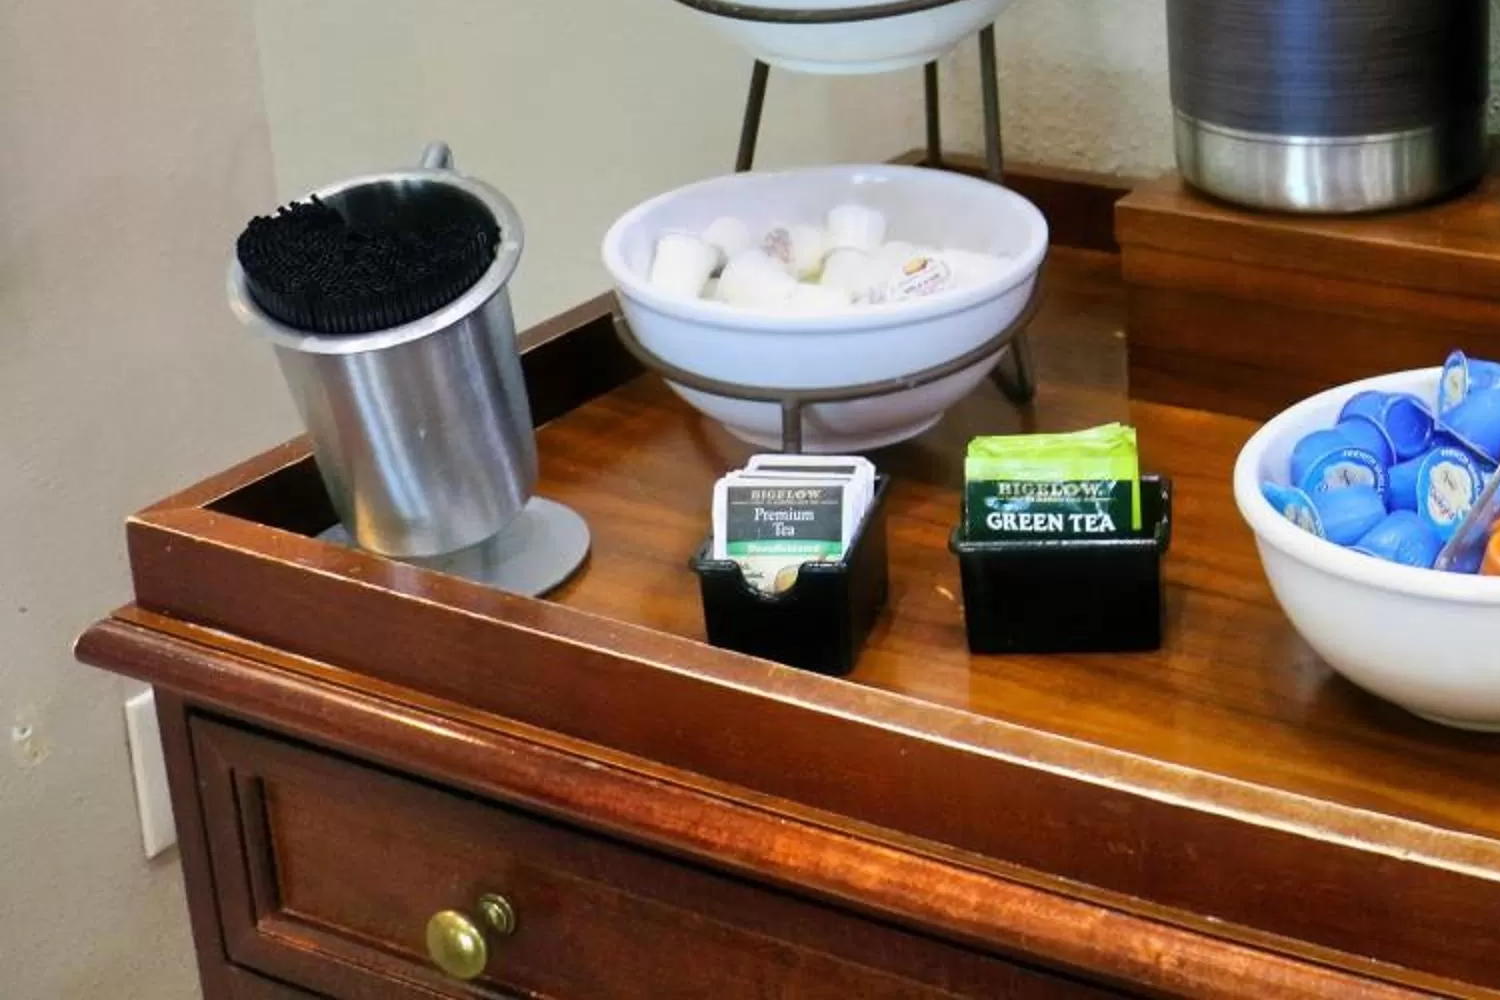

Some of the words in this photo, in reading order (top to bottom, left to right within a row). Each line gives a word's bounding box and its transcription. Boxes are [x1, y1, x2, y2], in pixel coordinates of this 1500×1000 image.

[754, 507, 815, 522] Premium
[986, 512, 1063, 531] GREEN
[1068, 513, 1116, 532] TEA
[772, 521, 795, 536] Tea
